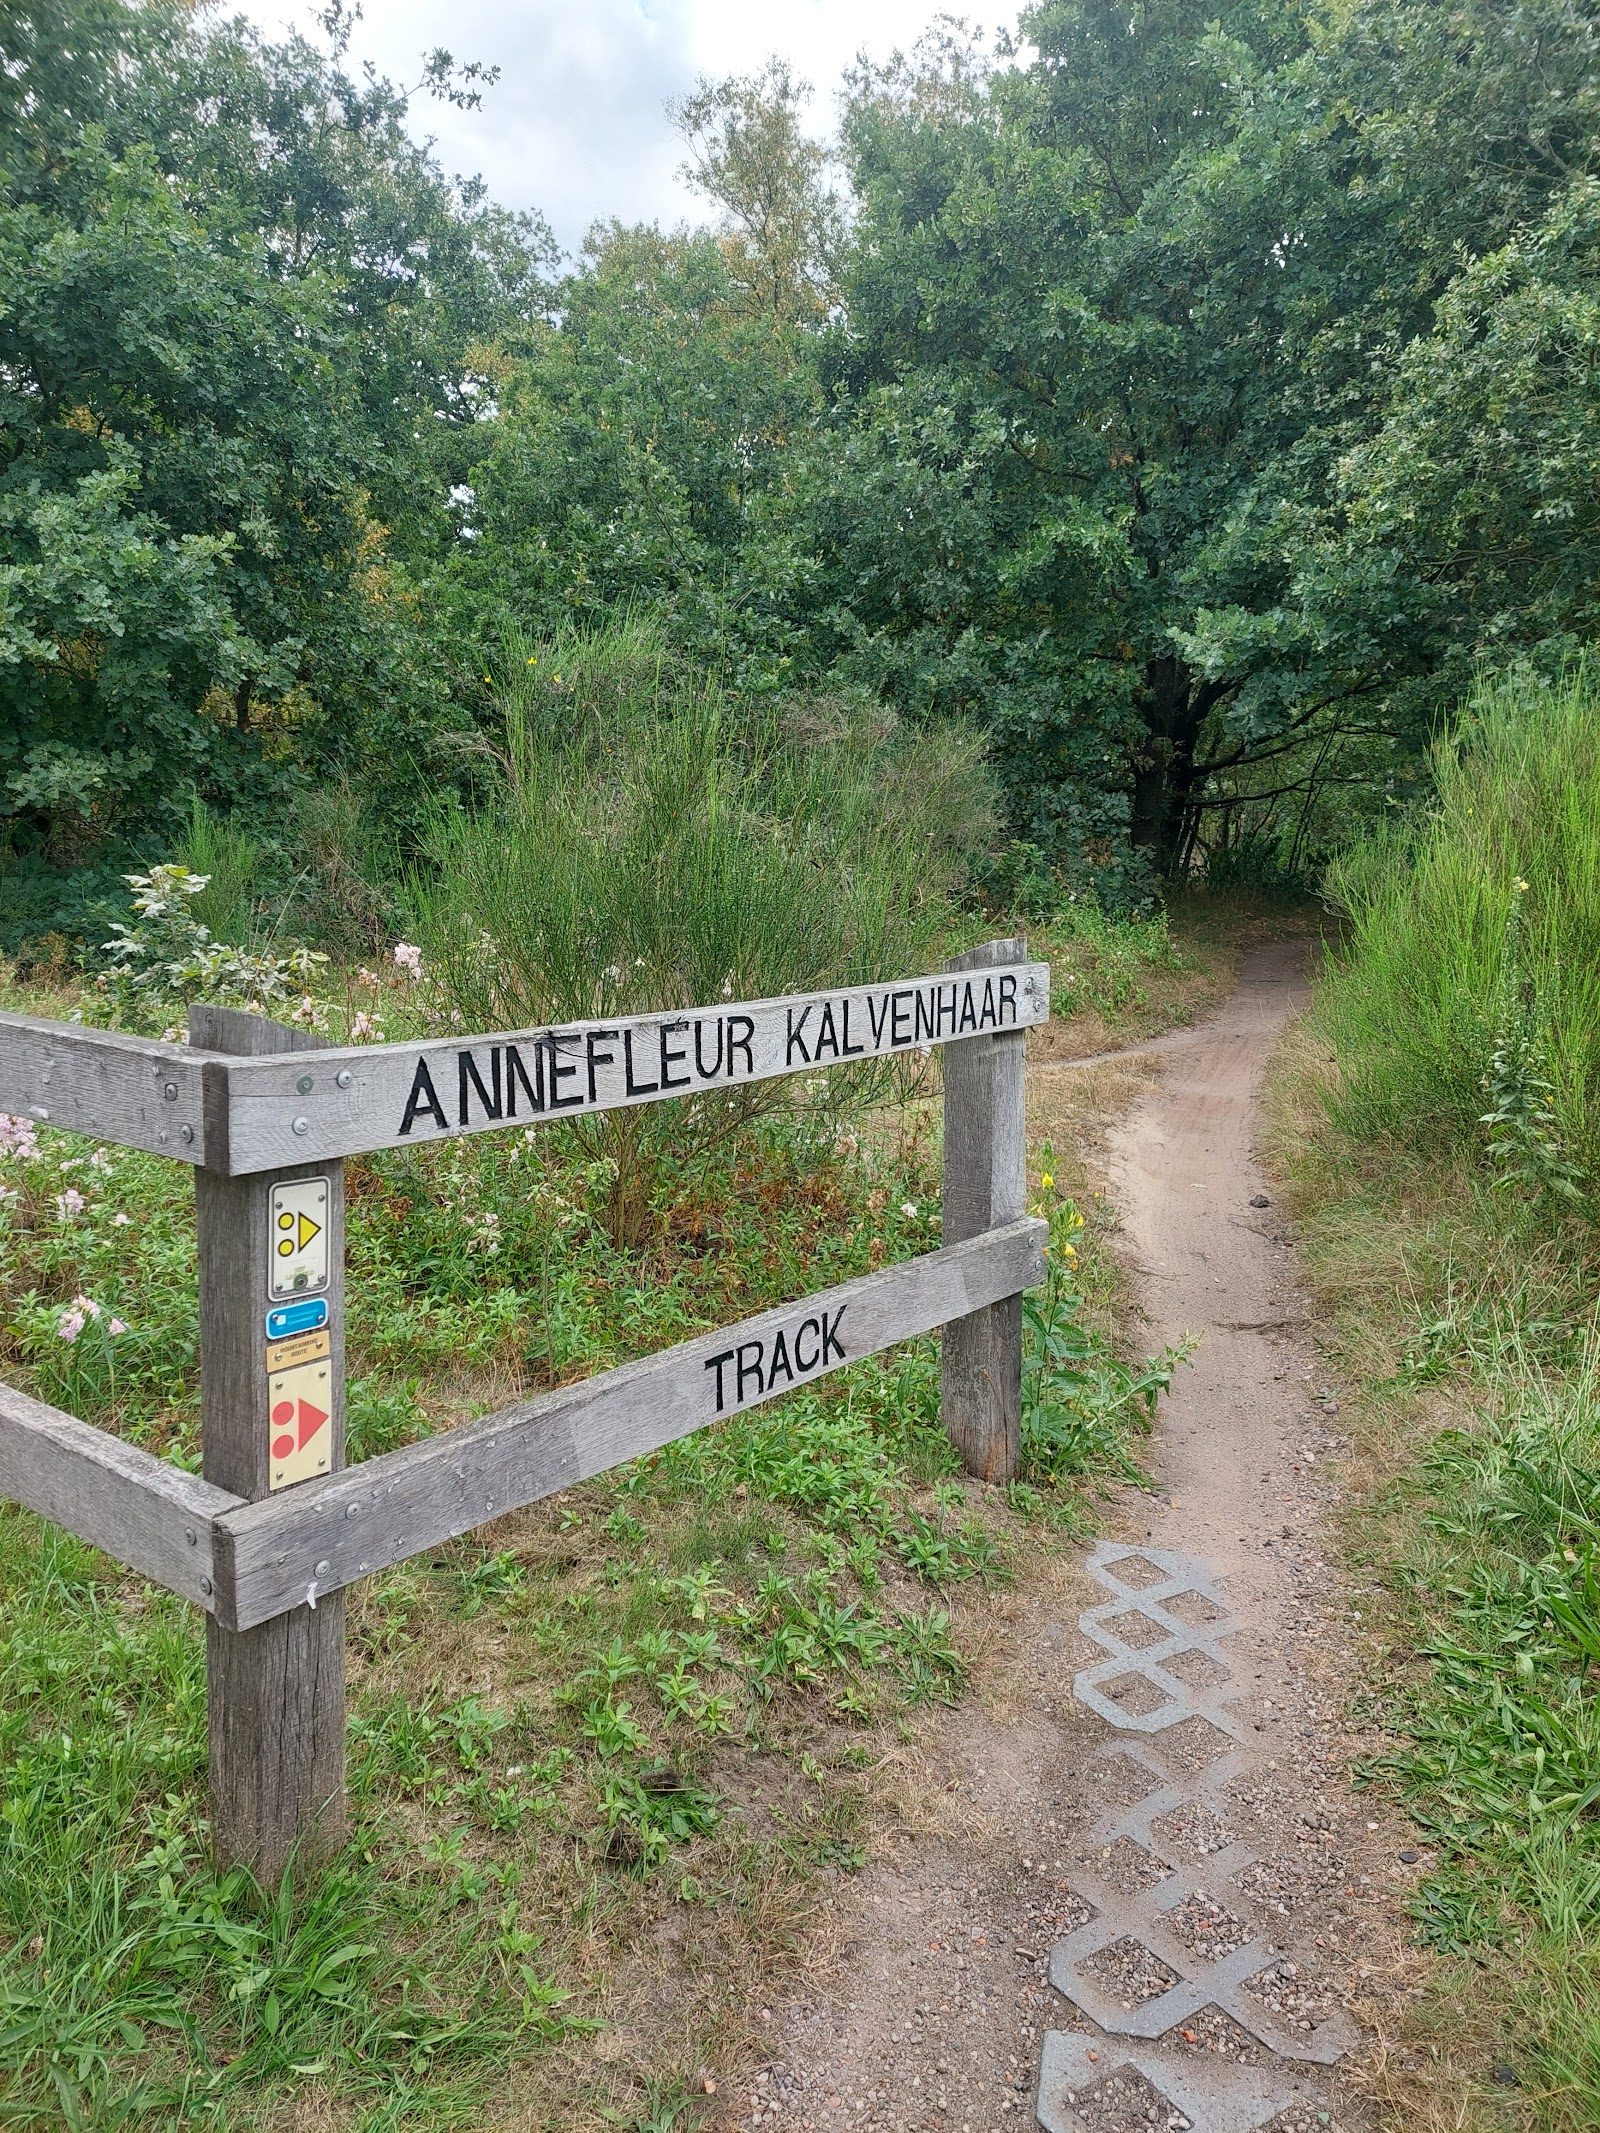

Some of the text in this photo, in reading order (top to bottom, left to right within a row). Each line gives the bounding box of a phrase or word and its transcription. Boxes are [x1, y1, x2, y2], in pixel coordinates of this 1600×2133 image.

[398, 975, 1018, 1135] ANNEFLEUR KALVENHAAR
[290, 1348, 308, 1358] ROUTE
[704, 1304, 848, 1412] TRACK
